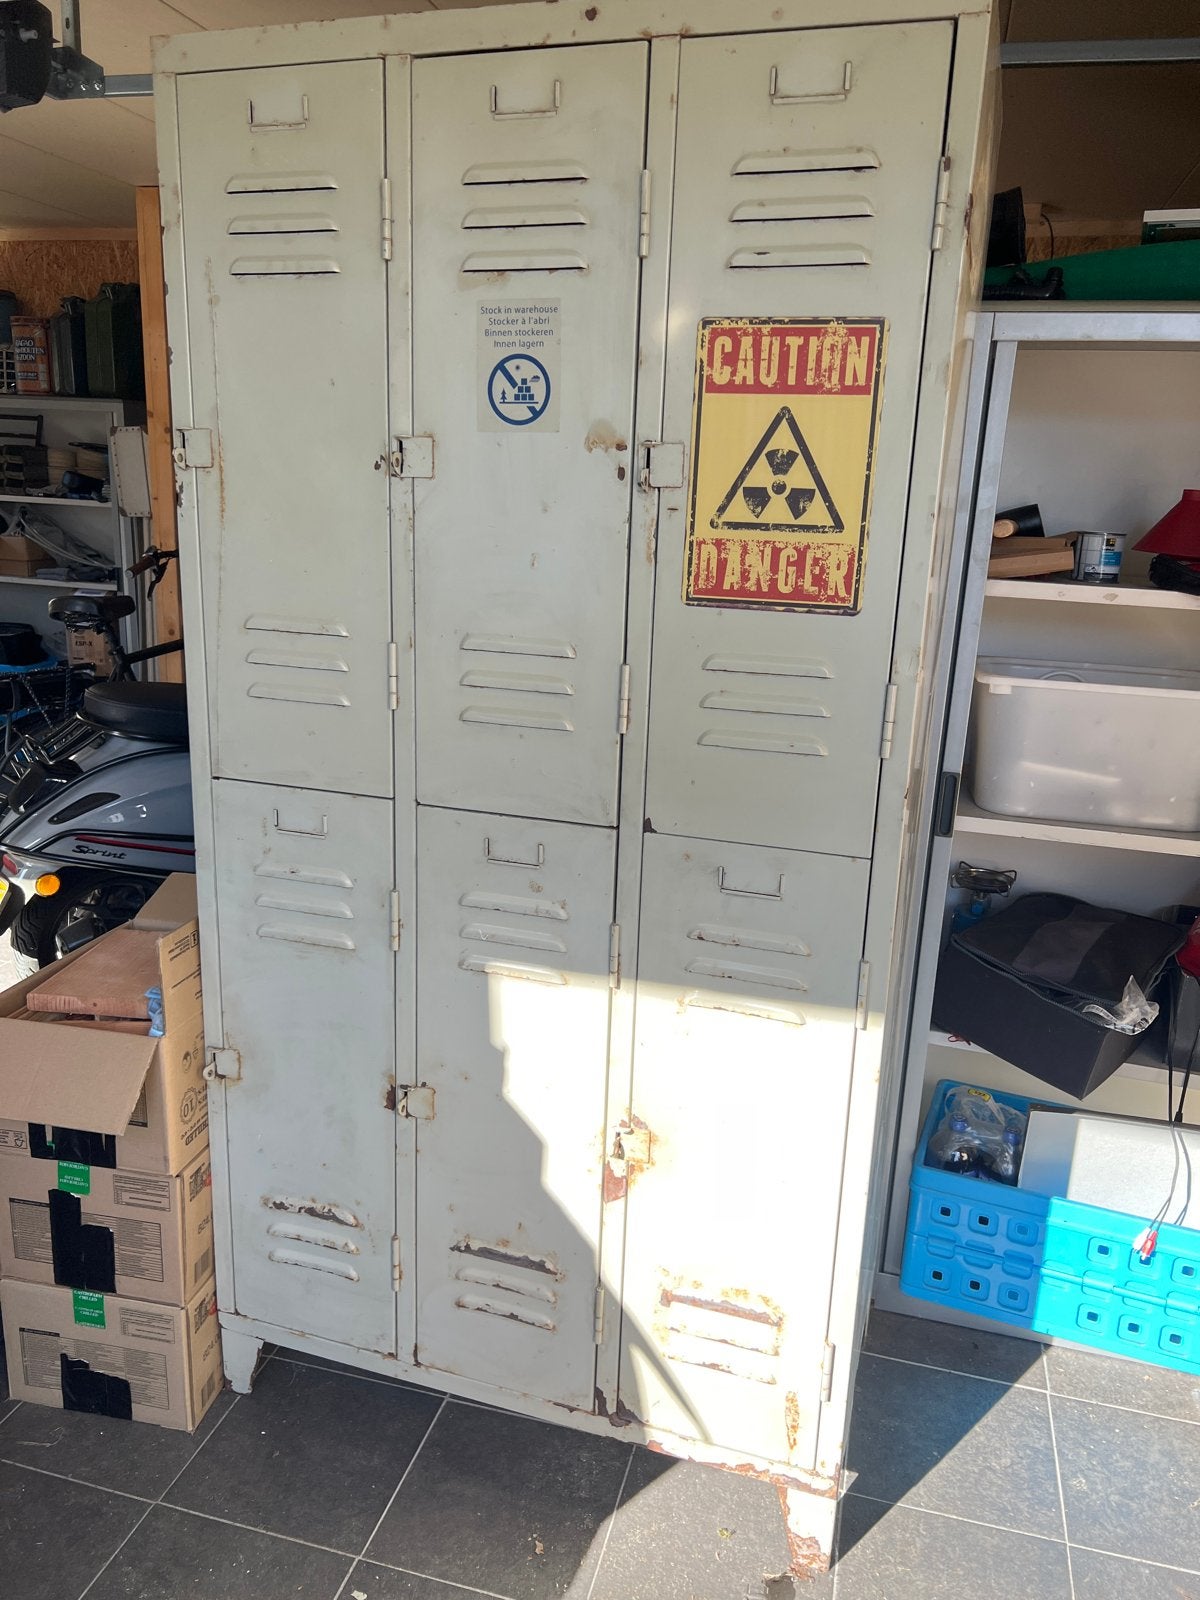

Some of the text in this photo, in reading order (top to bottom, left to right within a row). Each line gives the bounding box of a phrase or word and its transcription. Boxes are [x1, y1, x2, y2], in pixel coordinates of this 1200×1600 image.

[480, 305, 559, 315] Stock in warehouse
[488, 316, 550, 326] Stocker à l'abri
[484, 328, 554, 337] Binnen stockeren
[493, 339, 544, 350] Innen lagern
[711, 335, 871, 389] CAUTION
[699, 543, 849, 598] DANGER
[71, 844, 127, 860] Sprint
[186, 1121, 209, 1146] HILLED
